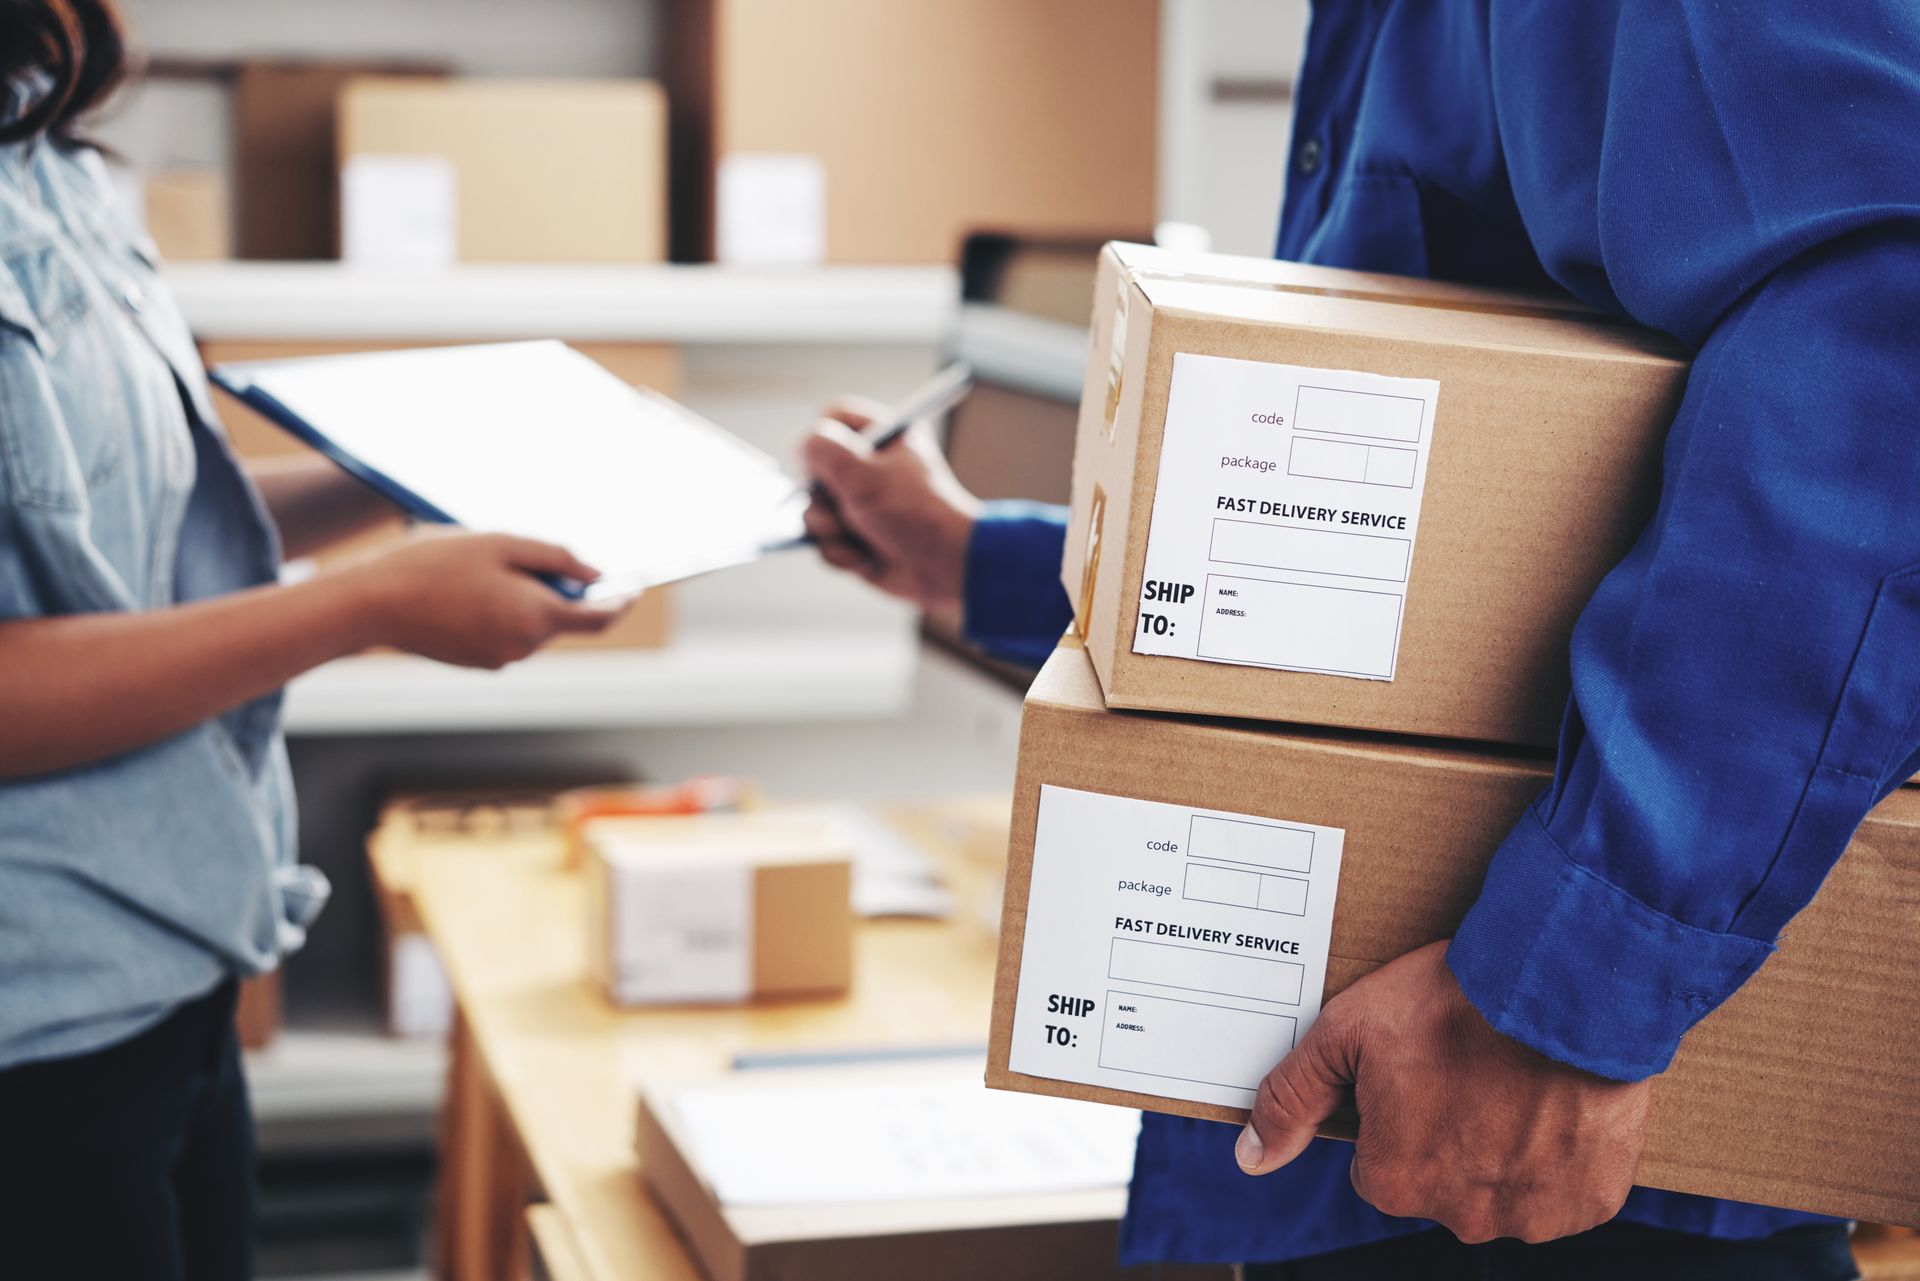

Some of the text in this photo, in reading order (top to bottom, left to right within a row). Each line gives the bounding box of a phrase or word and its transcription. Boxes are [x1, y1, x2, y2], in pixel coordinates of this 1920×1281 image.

[1252, 412, 1284, 426] code
[1221, 455, 1277, 474] package
[1217, 496, 1407, 531] FAST DELIVERY SERVICE
[1144, 580, 1195, 605] SHIP
[1218, 588, 1239, 597] NAME:
[1215, 607, 1247, 618] ADDRESS:
[1141, 612, 1176, 637] TO:
[1146, 840, 1179, 853] code
[1118, 880, 1172, 897] package
[1115, 917, 1300, 955] FAST DELIVERY SERVICE
[1047, 994, 1096, 1018] SHIP
[1118, 1004, 1138, 1013] NAME:
[1044, 1024, 1078, 1048] TO:
[1116, 1022, 1146, 1033] ADDRESS:
